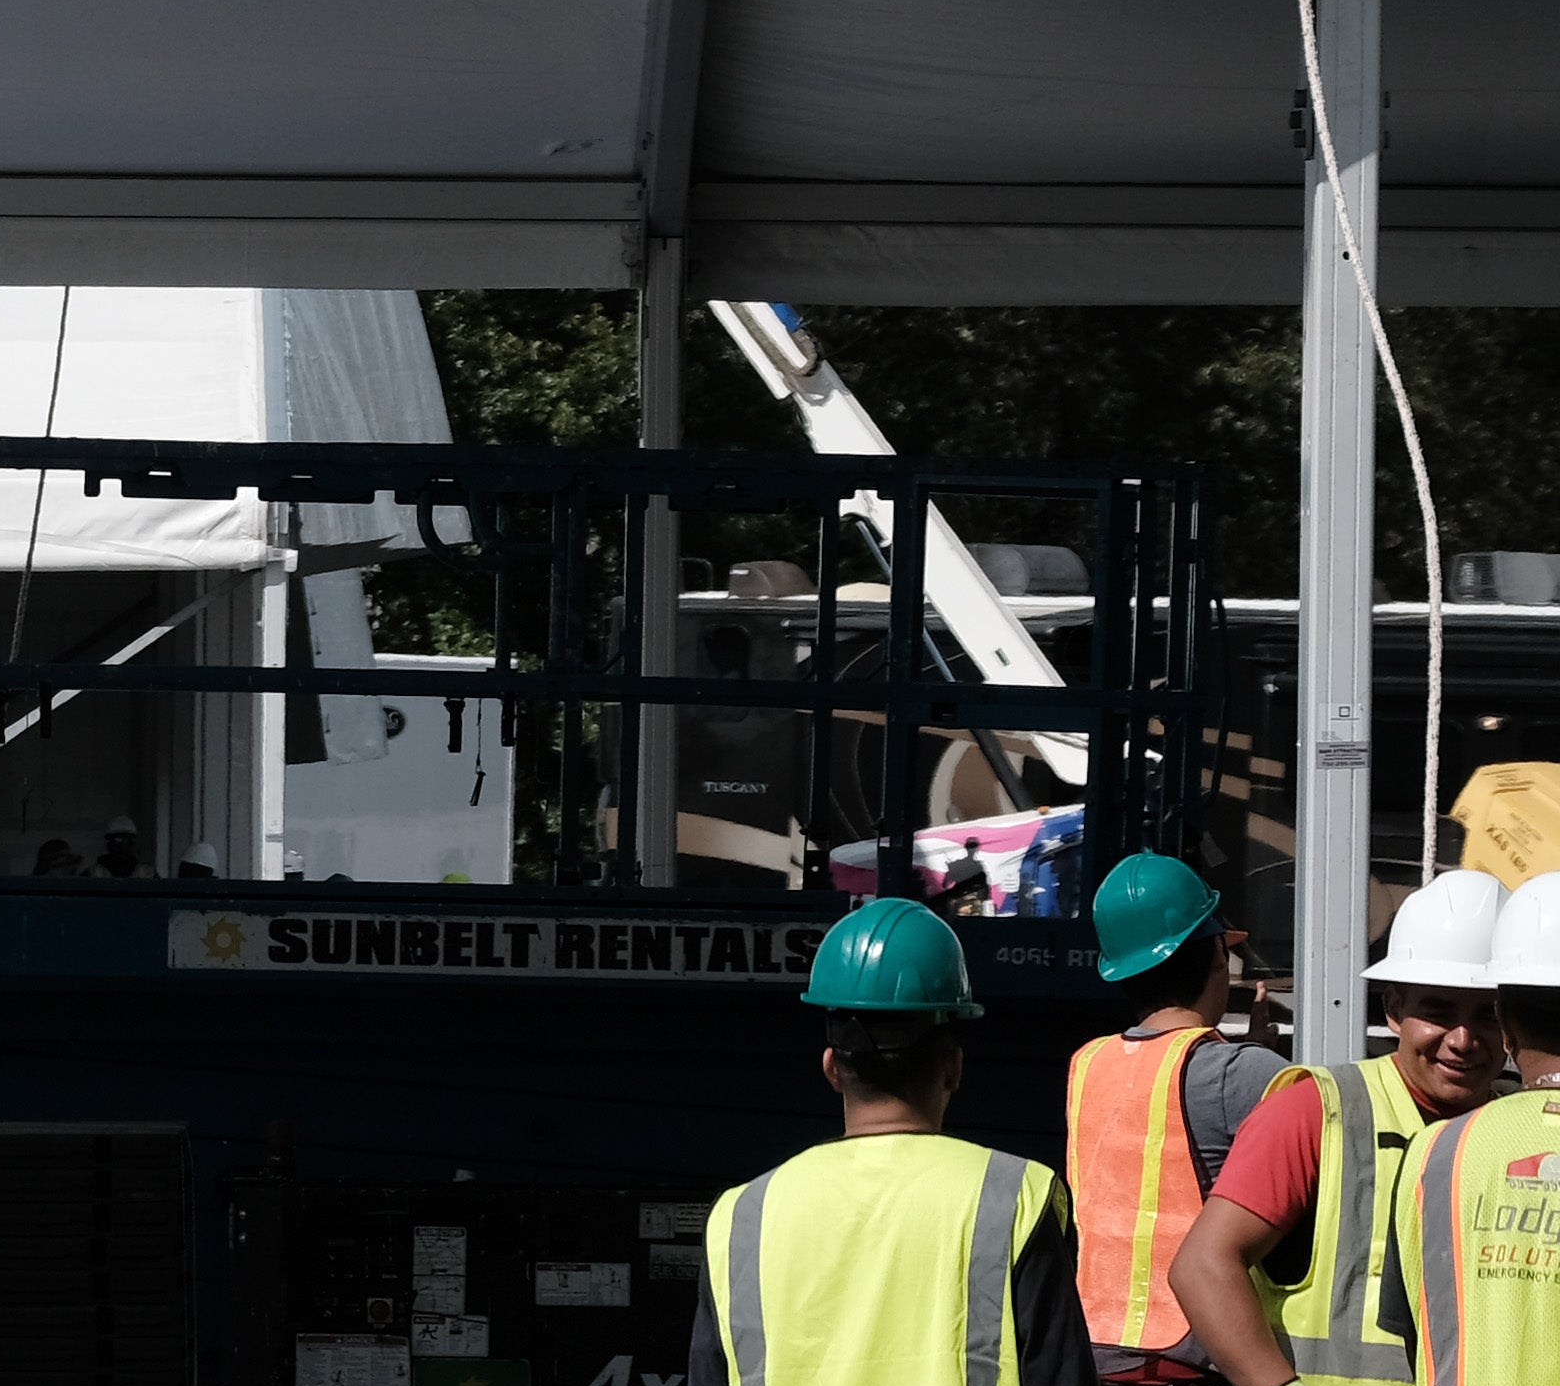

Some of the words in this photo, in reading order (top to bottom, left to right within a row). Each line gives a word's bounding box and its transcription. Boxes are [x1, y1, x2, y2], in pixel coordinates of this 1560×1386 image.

[703, 780, 769, 794] TUSCANY
[267, 917, 543, 970] SUNBELT
[556, 919, 823, 975] RENTALS
[1477, 1267, 1551, 1282] EMERGENCY
